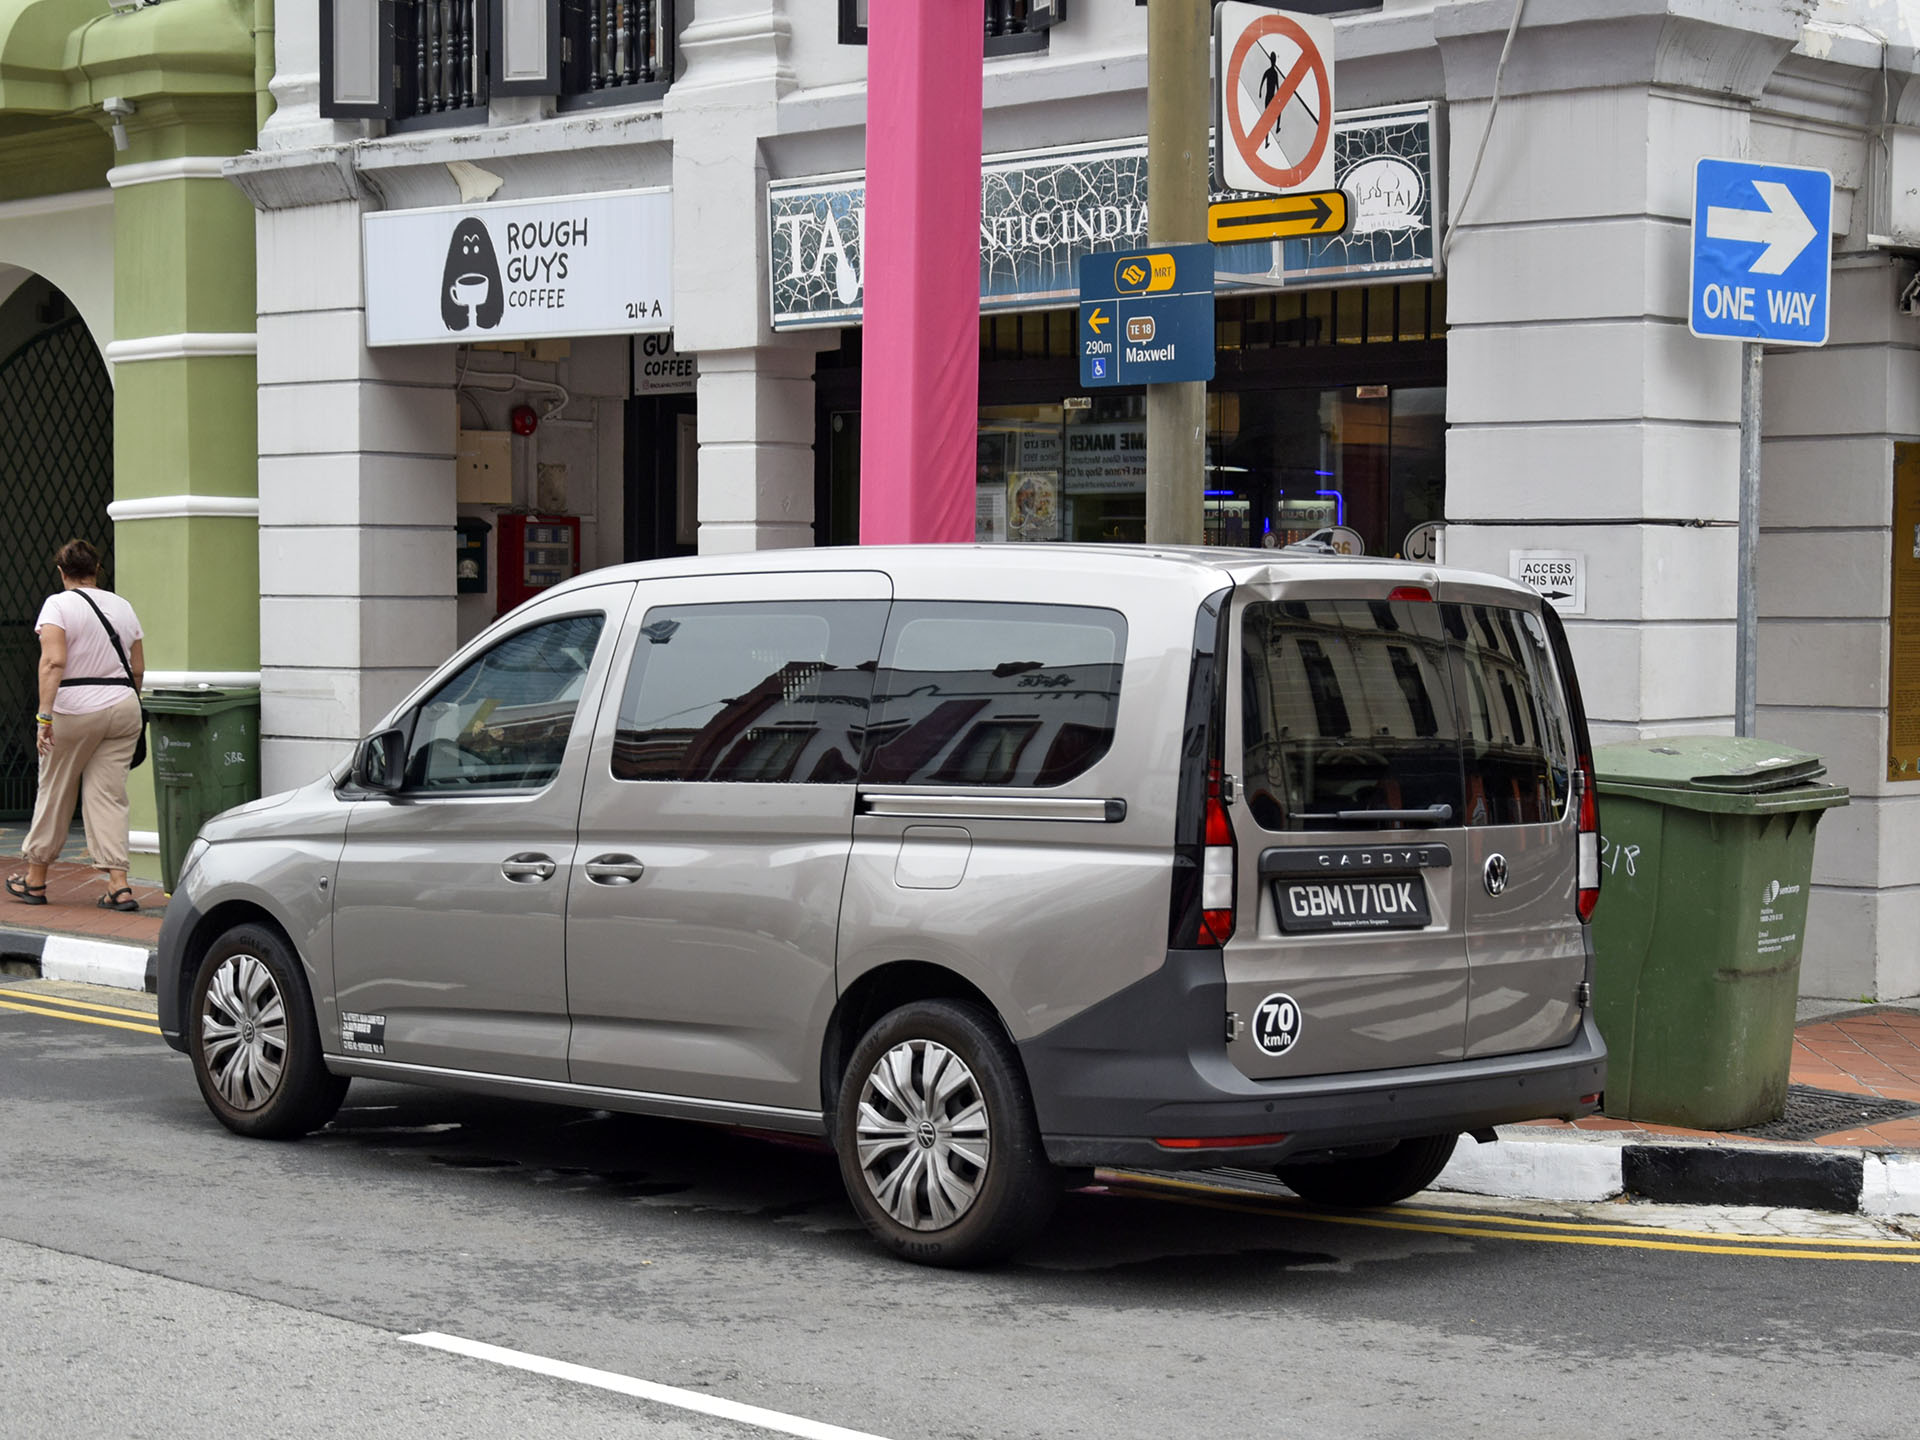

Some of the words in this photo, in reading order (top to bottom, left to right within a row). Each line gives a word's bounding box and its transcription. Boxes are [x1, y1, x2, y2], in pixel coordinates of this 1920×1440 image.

[1383, 190, 1411, 208] TAJ
[507, 217, 588, 255] ROUGH
[980, 212, 1050, 248] NTIC
[506, 252, 569, 284] GUYS
[1154, 266, 1172, 278] MRT
[508, 288, 566, 310] COFFEE
[1703, 283, 1756, 321] ONE
[1767, 289, 1816, 326] WAY
[625, 301, 648, 320] 214
[651, 299, 663, 318] A
[1129, 324, 1140, 335] TE
[1142, 323, 1152, 334] 18
[1086, 340, 1112, 355] 290m
[1125, 344, 1175, 363] Maxwell
[644, 359, 693, 378] COFFEE
[1524, 563, 1571, 574] ACCESS
[1521, 575, 1547, 586] THIS
[1550, 575, 1575, 586] WAY
[1318, 852, 1411, 866] CADDY
[1288, 883, 1417, 917] GBM1710K
[1262, 1002, 1294, 1033] 70
[1263, 1033, 1291, 1047] km/h
